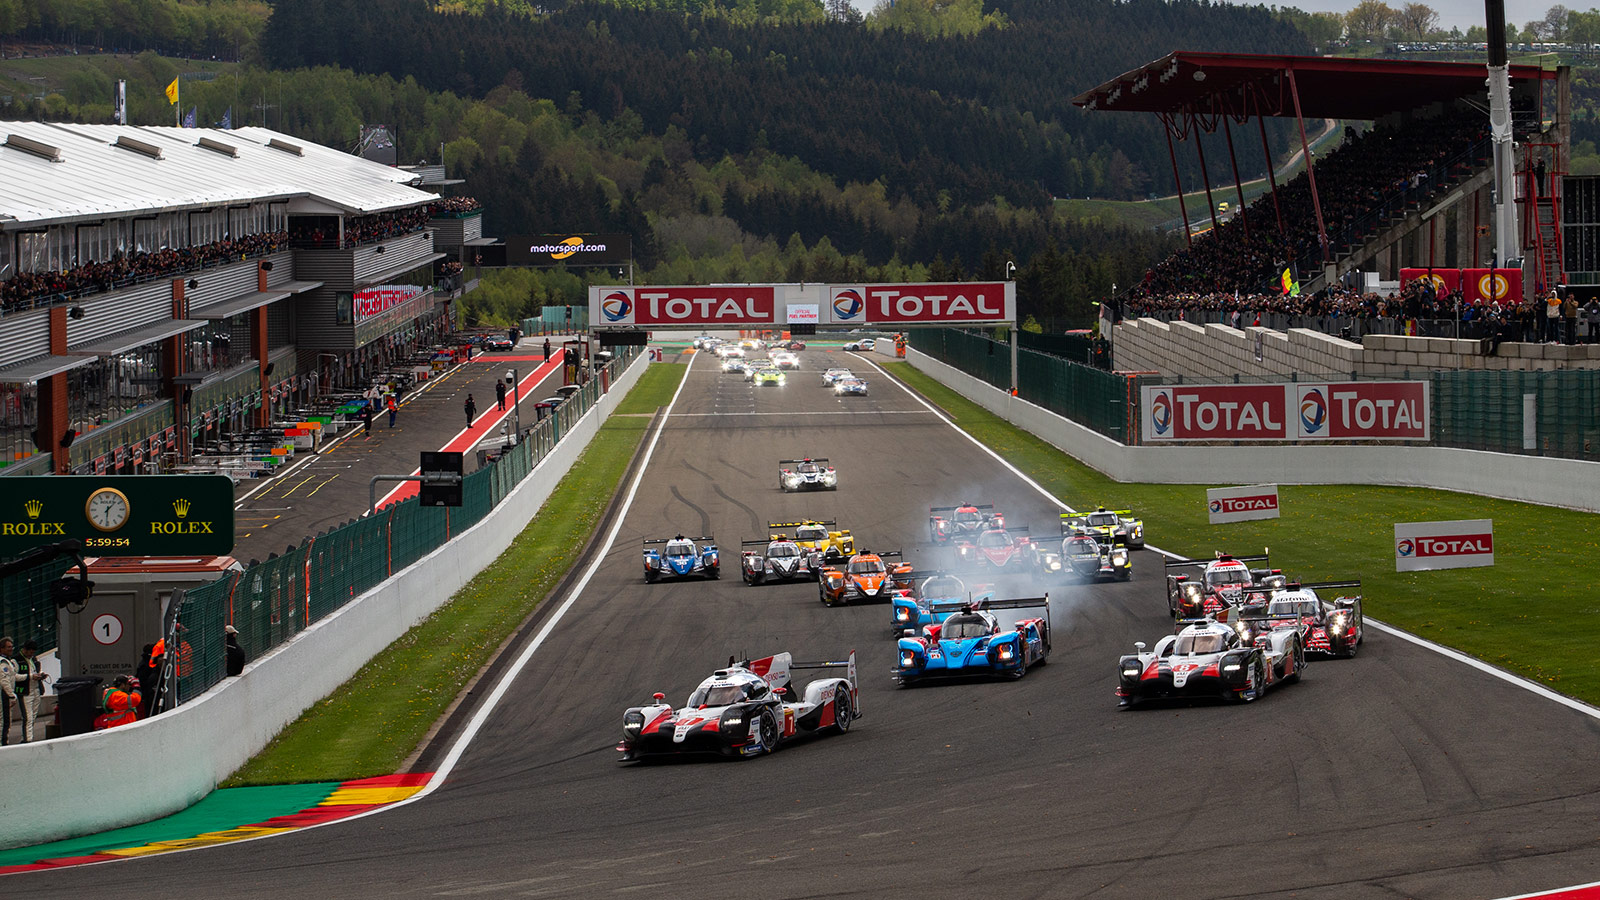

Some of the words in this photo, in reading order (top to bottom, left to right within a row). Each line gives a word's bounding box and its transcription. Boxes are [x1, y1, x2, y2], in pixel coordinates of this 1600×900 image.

[530, 244, 606, 254] motorsport.com
[640, 292, 769, 319] TOTAL
[872, 290, 1000, 317] TOTAL
[1177, 394, 1282, 431] TOTAL
[1333, 391, 1423, 429] TOTAL
[1224, 499, 1276, 511] TOTAL
[2, 522, 66, 536] ROLEX
[150, 521, 214, 535] ROLEX
[85, 537, 130, 547] 5:59:54
[1418, 539, 1490, 554] TOTAL
[102, 622, 111, 637] 1
[788, 716, 794, 733] 7
